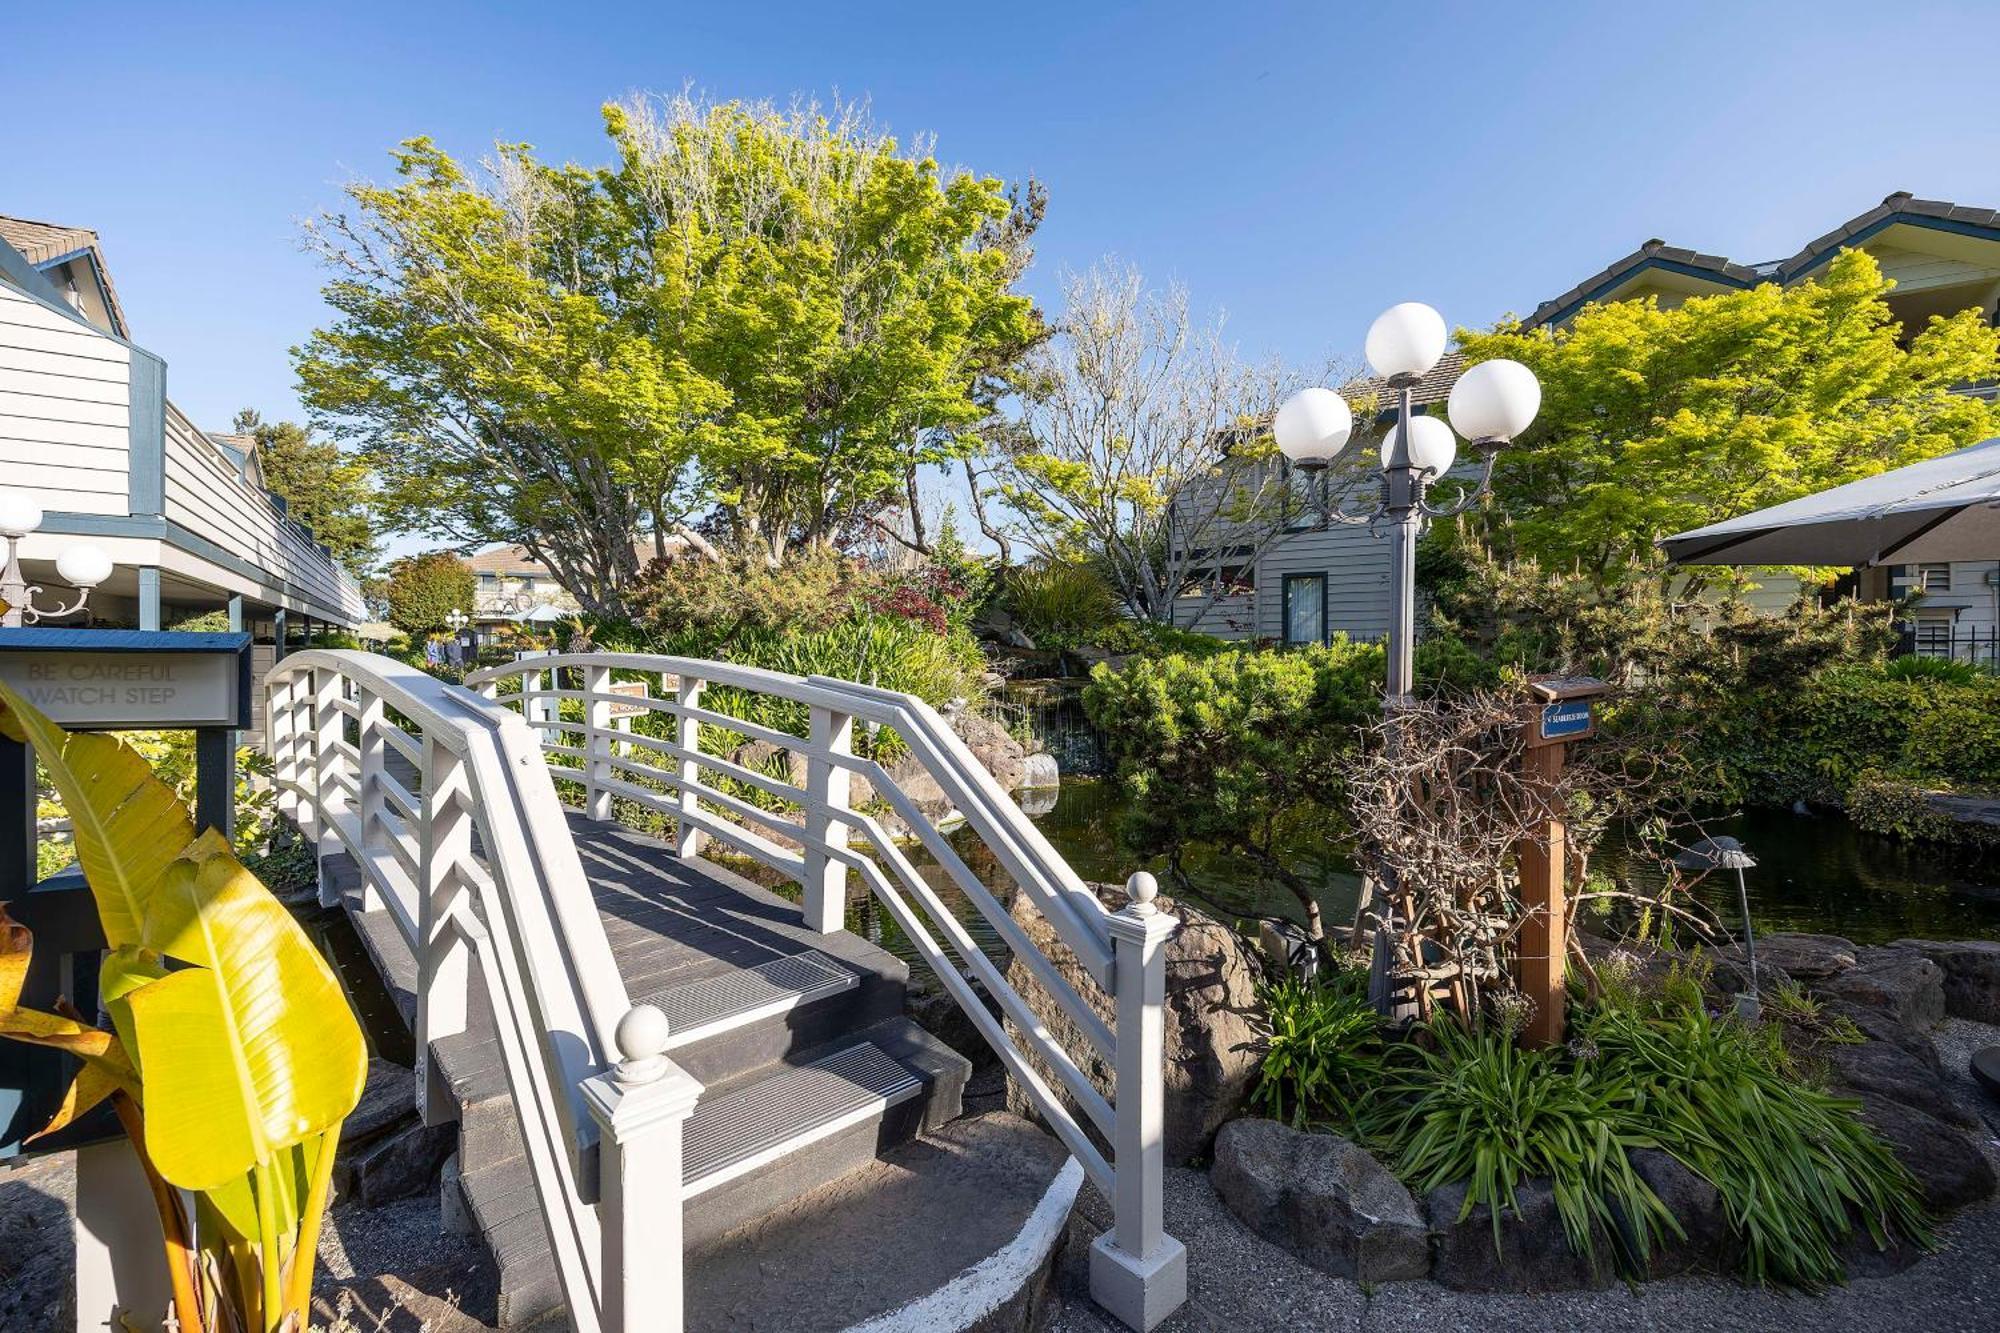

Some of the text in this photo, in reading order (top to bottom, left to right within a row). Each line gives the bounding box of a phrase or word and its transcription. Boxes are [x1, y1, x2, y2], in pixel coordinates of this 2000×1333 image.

[29, 663, 177, 681] BE CAREFUL
[27, 687, 177, 704] WATCH STEP
